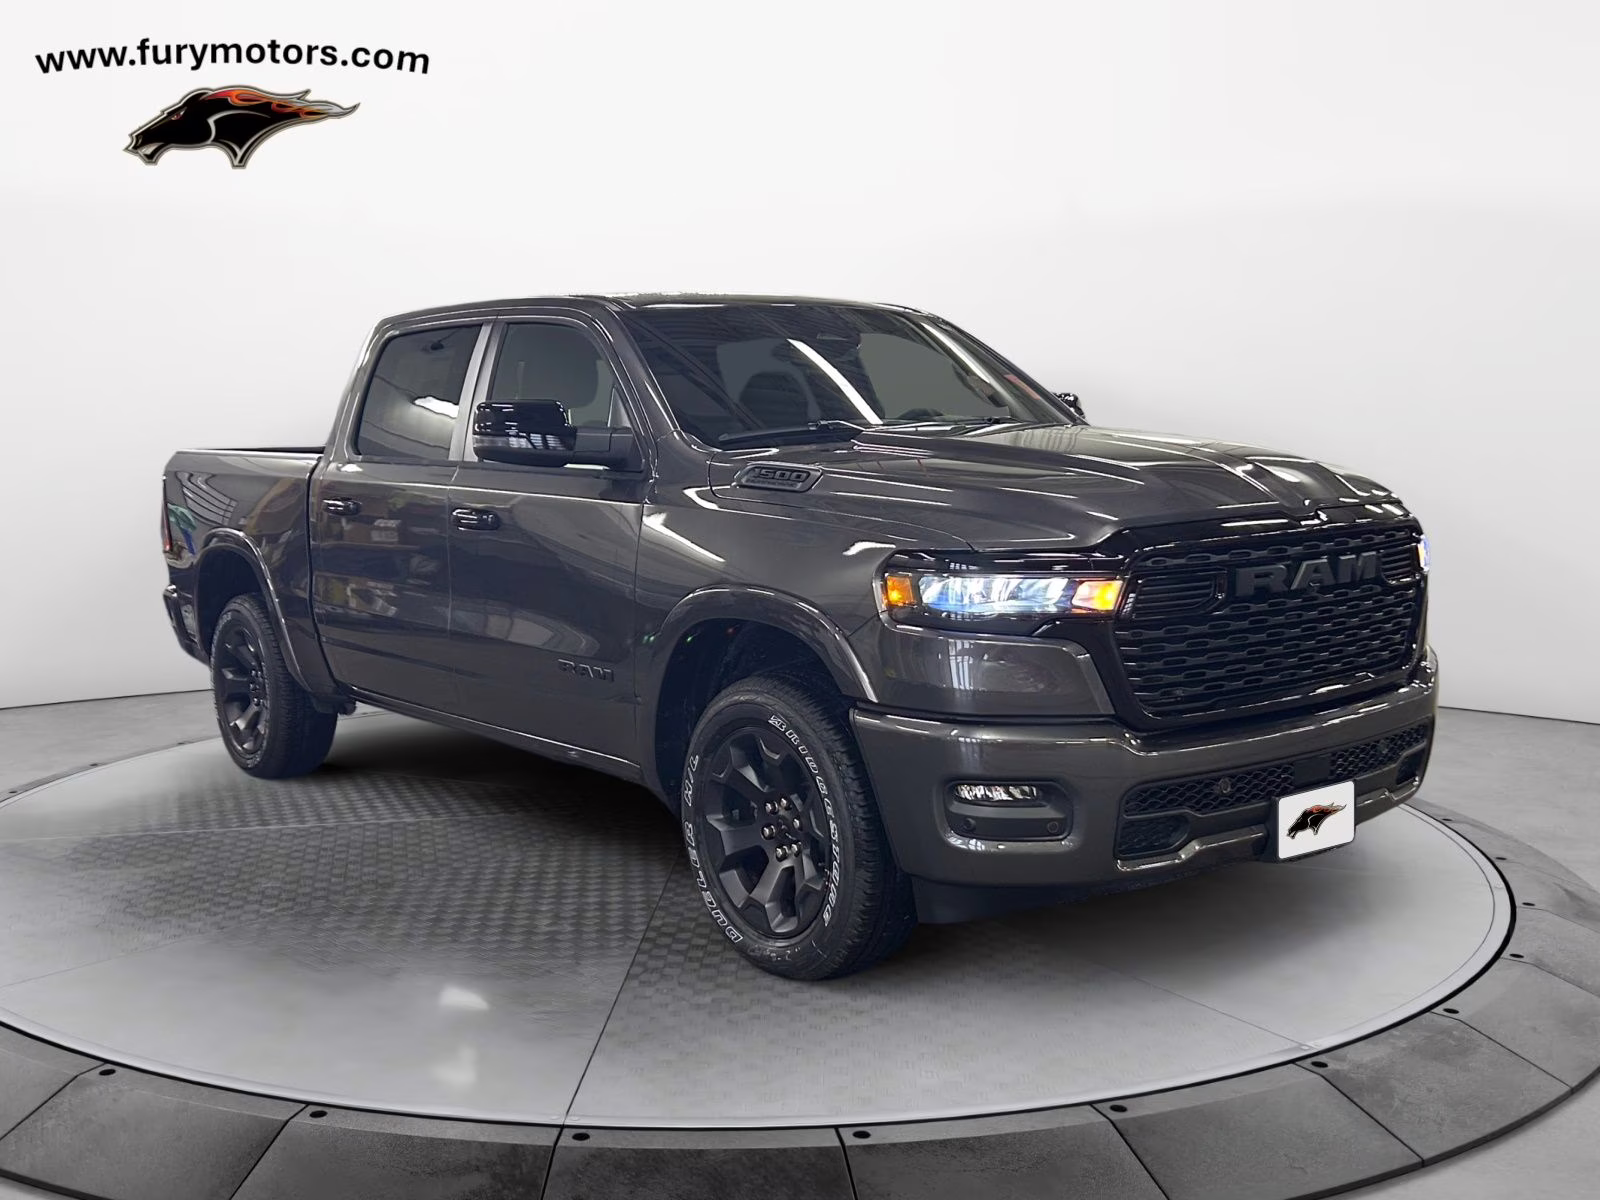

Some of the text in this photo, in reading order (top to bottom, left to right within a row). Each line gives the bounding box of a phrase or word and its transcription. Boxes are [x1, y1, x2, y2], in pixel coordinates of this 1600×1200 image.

[751, 468, 806, 482] 1500
[1235, 551, 1377, 597] RAM
[557, 659, 615, 682] RAM
[767, 714, 841, 927] BRIDGESTONE
[684, 821, 744, 944] DUELER
